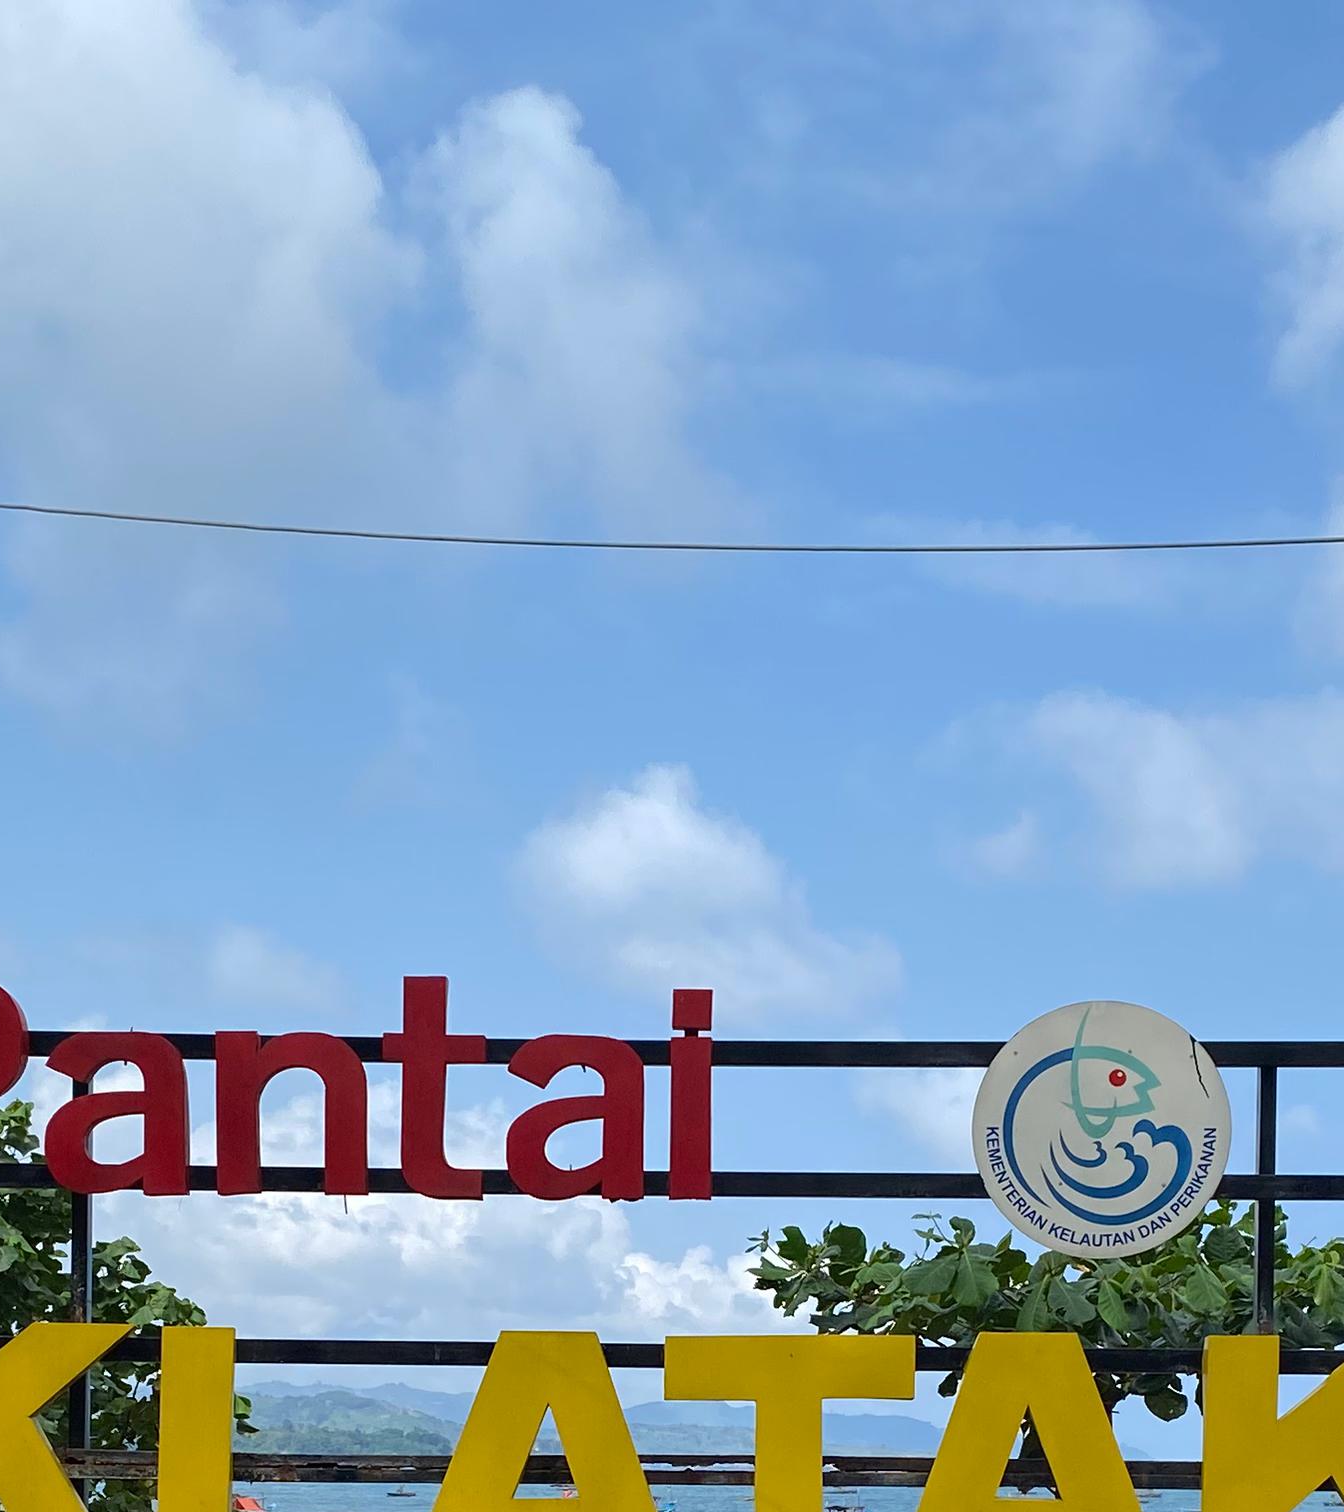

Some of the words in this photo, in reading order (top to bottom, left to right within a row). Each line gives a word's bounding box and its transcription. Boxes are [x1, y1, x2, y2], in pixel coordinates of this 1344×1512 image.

[986, 1126, 1047, 1230] KEMENTERIAN
[1047, 1224, 1136, 1247] KELAUTAN
[1138, 1211, 1172, 1239] DAN
[1170, 1127, 1217, 1216] PERIKANAN
